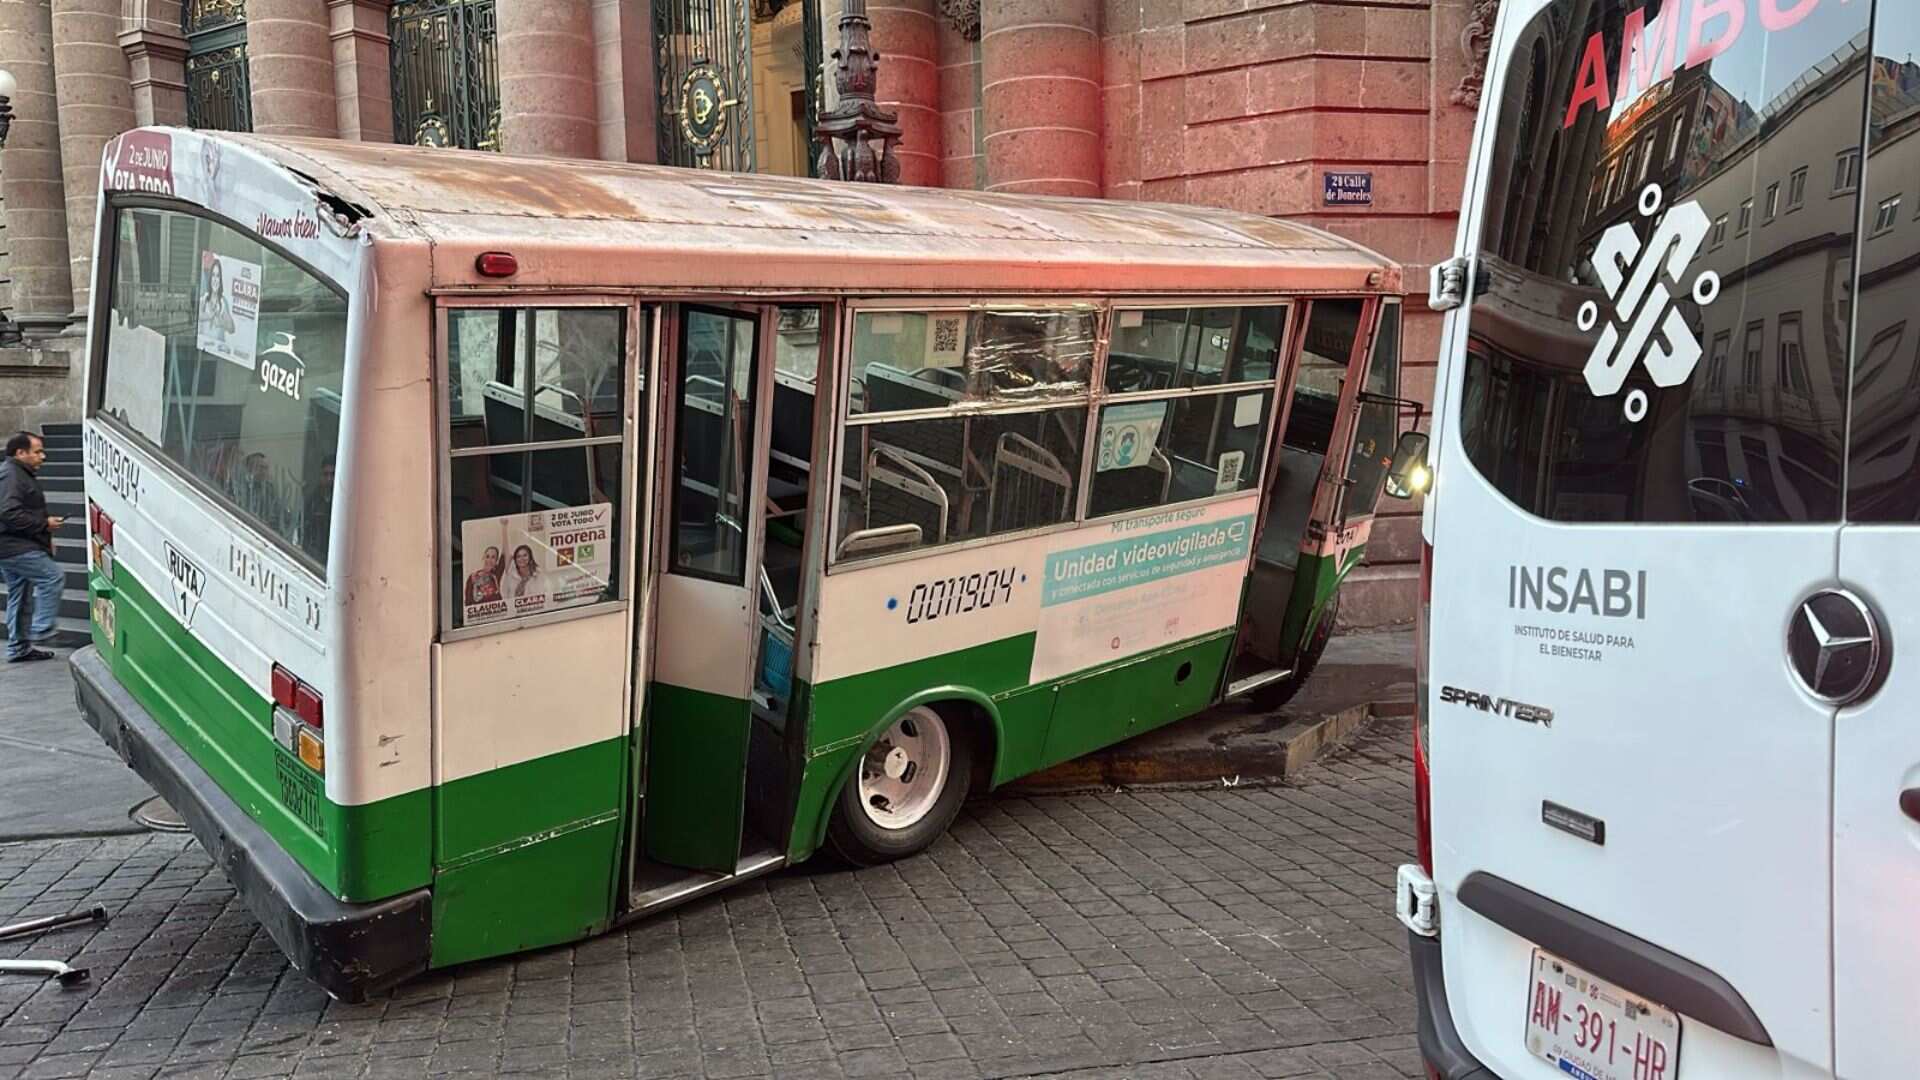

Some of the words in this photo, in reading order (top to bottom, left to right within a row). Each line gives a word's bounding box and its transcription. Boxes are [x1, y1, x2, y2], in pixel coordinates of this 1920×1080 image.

[1344, 175, 1366, 187] Calle
[260, 359, 300, 400] gazel
[550, 530, 606, 547] morena
[1054, 548, 1118, 581] Unidad
[1122, 527, 1226, 567] videovigilada
[169, 550, 199, 597] RUTA
[1509, 566, 1647, 619] INSABI
[181, 591, 188, 616] 1
[467, 601, 507, 614] CLAUDIA
[906, 566, 1016, 624] 0011904
[1515, 624, 1557, 640] INSTITUTO
[1558, 629, 1571, 641] DE
[1572, 631, 1604, 646] SALUD
[1606, 635, 1635, 649] PARA
[1539, 643, 1550, 655] EL
[1551, 645, 1603, 661] BIENESTAR
[1440, 685, 1555, 728] SPRINTER
[1532, 980, 1667, 1080] AM-391-HR
